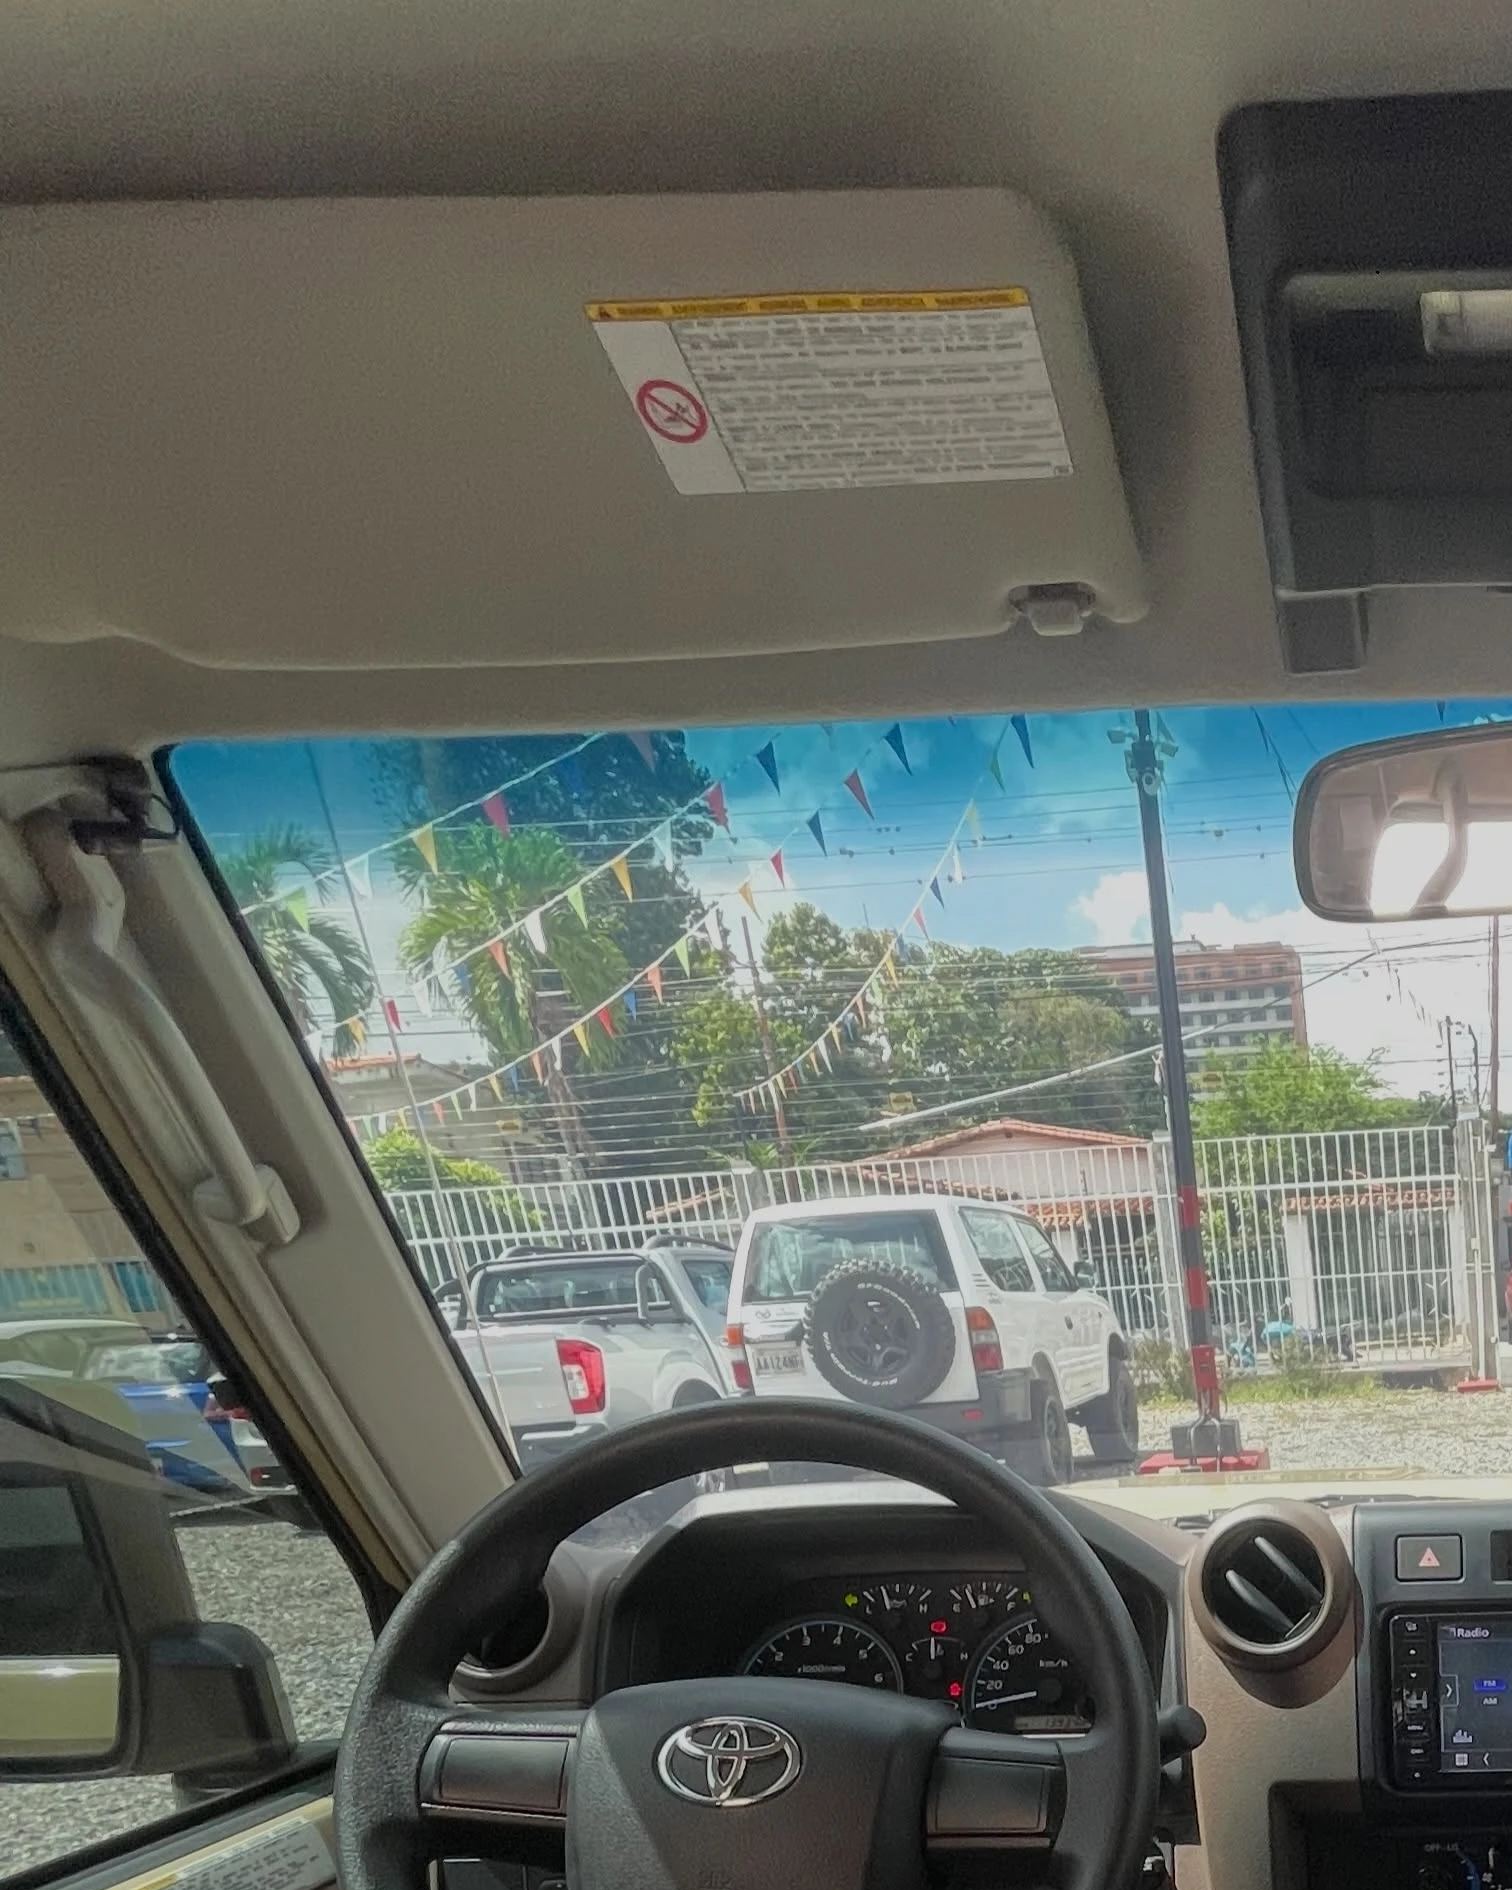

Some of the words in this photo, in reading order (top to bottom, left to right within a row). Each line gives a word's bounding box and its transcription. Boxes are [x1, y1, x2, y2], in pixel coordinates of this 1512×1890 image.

[1457, 1627, 1490, 1638] Radio
[1025, 1633, 1042, 1644] 80
[1008, 1645, 1024, 1656] 60
[992, 1660, 1009, 1671] 40
[1039, 1659, 1069, 1668] km/h
[986, 1679, 1003, 1690] 20
